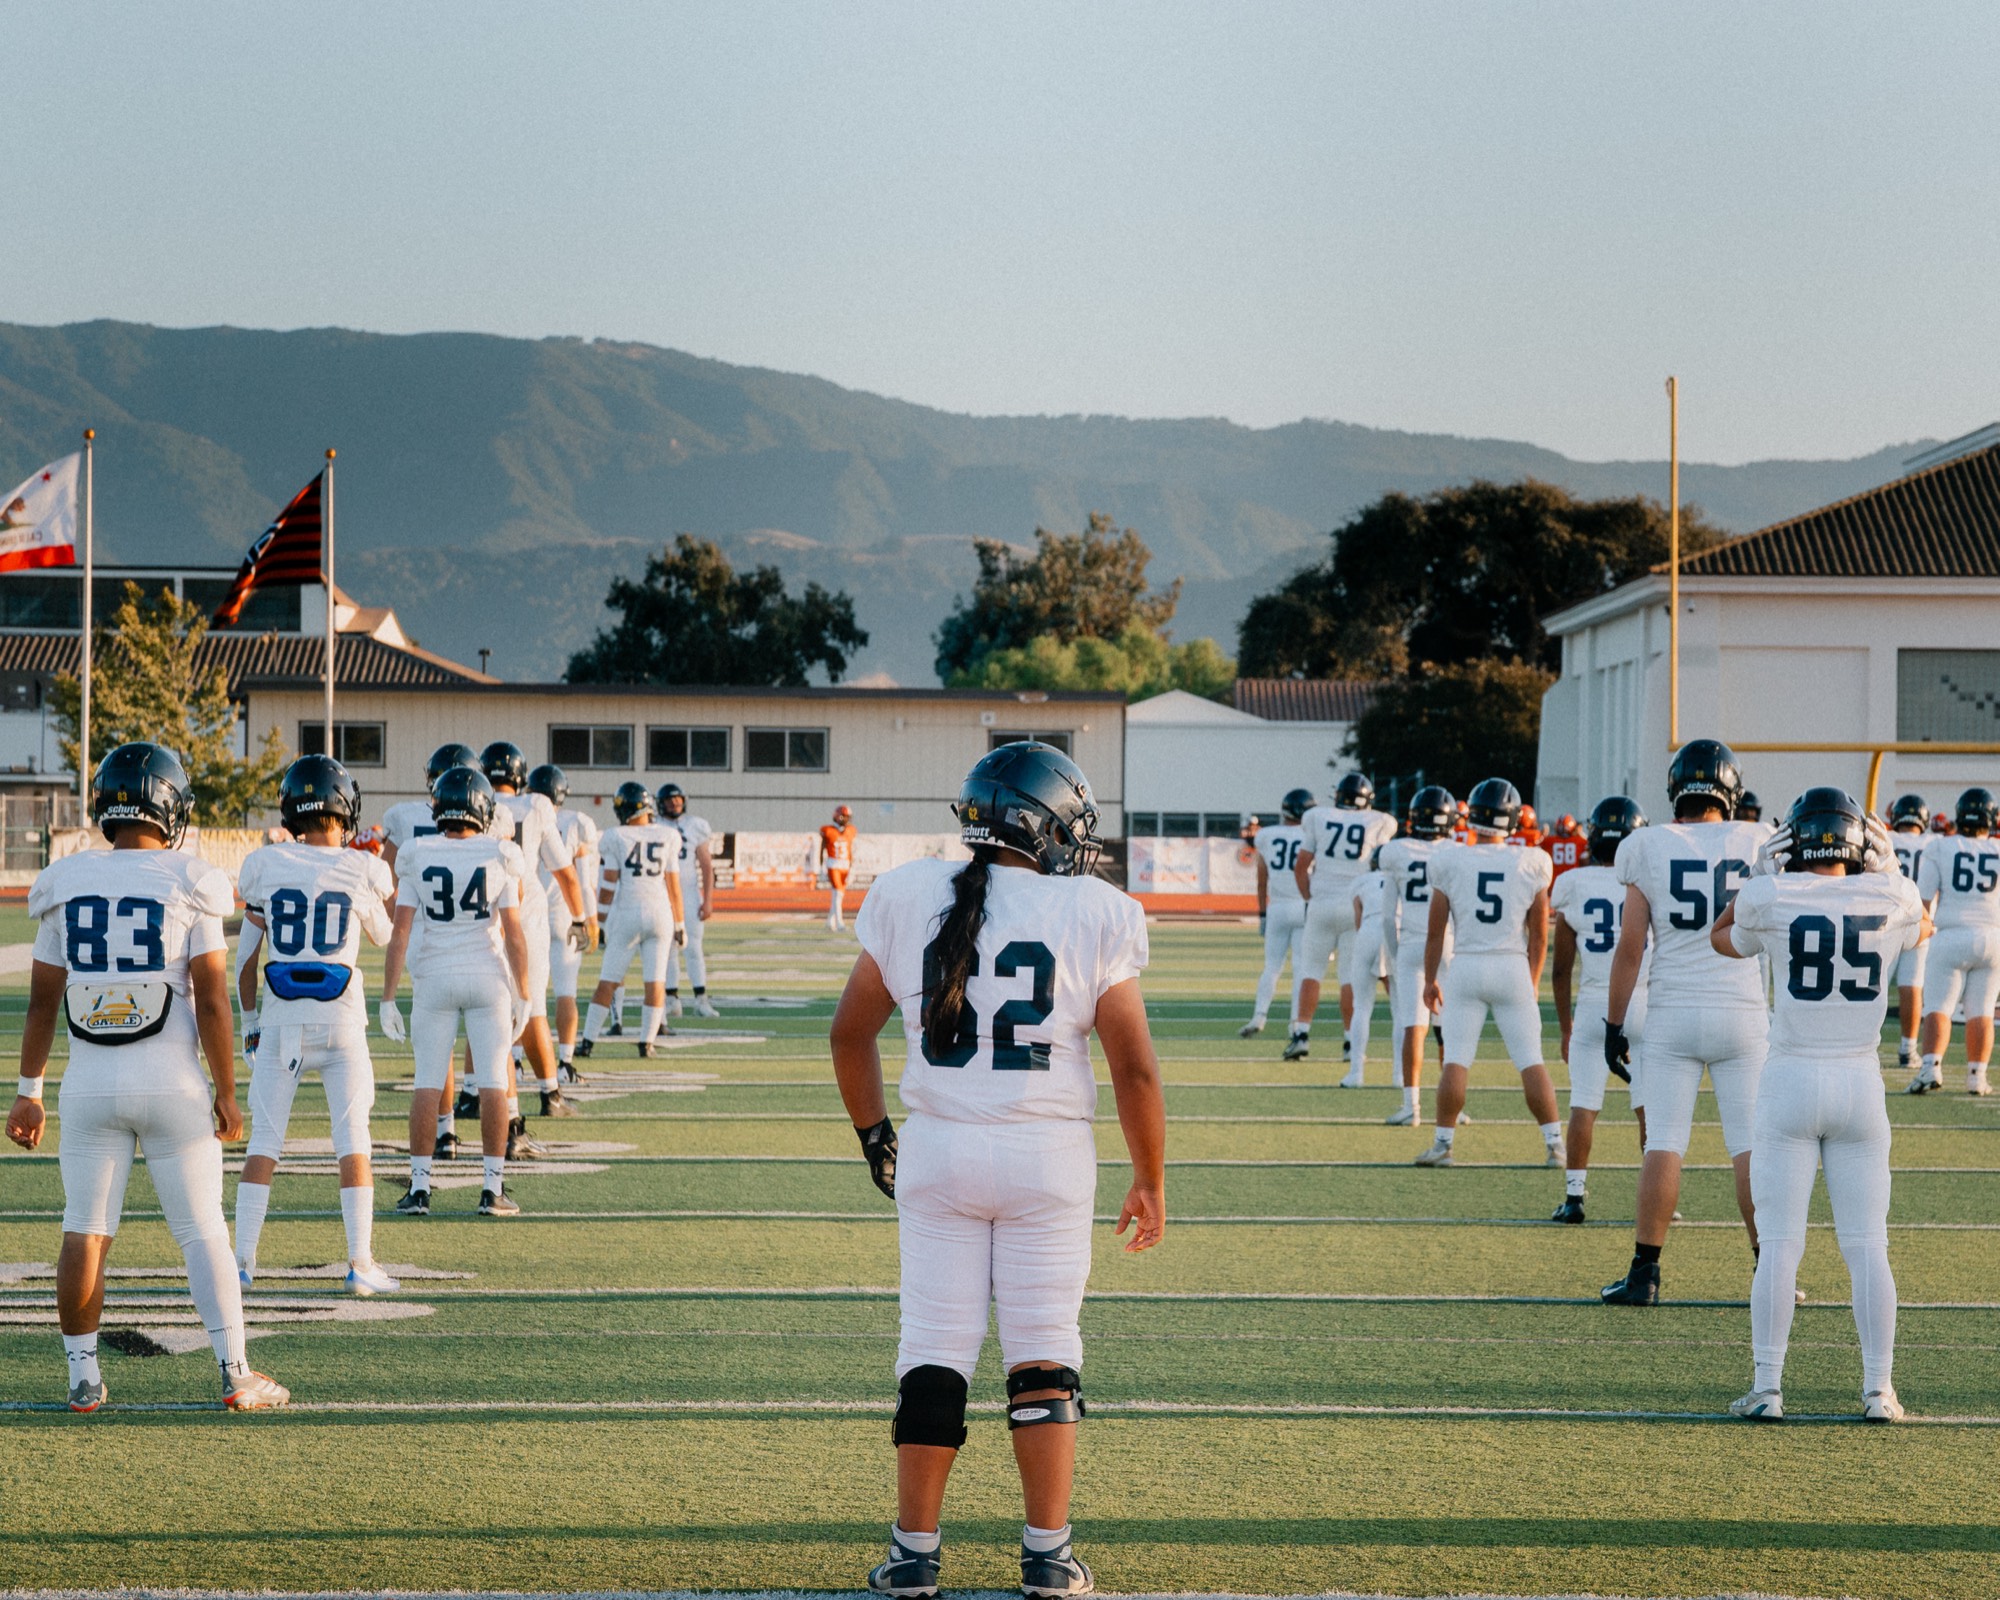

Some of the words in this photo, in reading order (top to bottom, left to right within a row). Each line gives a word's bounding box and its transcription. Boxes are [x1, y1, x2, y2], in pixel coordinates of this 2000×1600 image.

[117, 792, 128, 802] 83
[1686, 781, 1714, 791] schutt
[107, 802, 140, 814] schutt
[296, 801, 324, 813] LIGHT
[968, 807, 979, 820] 62
[962, 824, 990, 838] schutt
[1325, 821, 1366, 860] 79
[1822, 832, 1833, 844] 85
[624, 841, 664, 877] 45
[1803, 846, 1850, 860] Riddell
[1952, 851, 1999, 893] 65
[422, 865, 490, 923] 34
[1476, 871, 1504, 924] 5
[65, 894, 165, 973] 83
[270, 887, 353, 957] 80
[1583, 898, 1627, 953] 3
[1787, 914, 1888, 1002] 85
